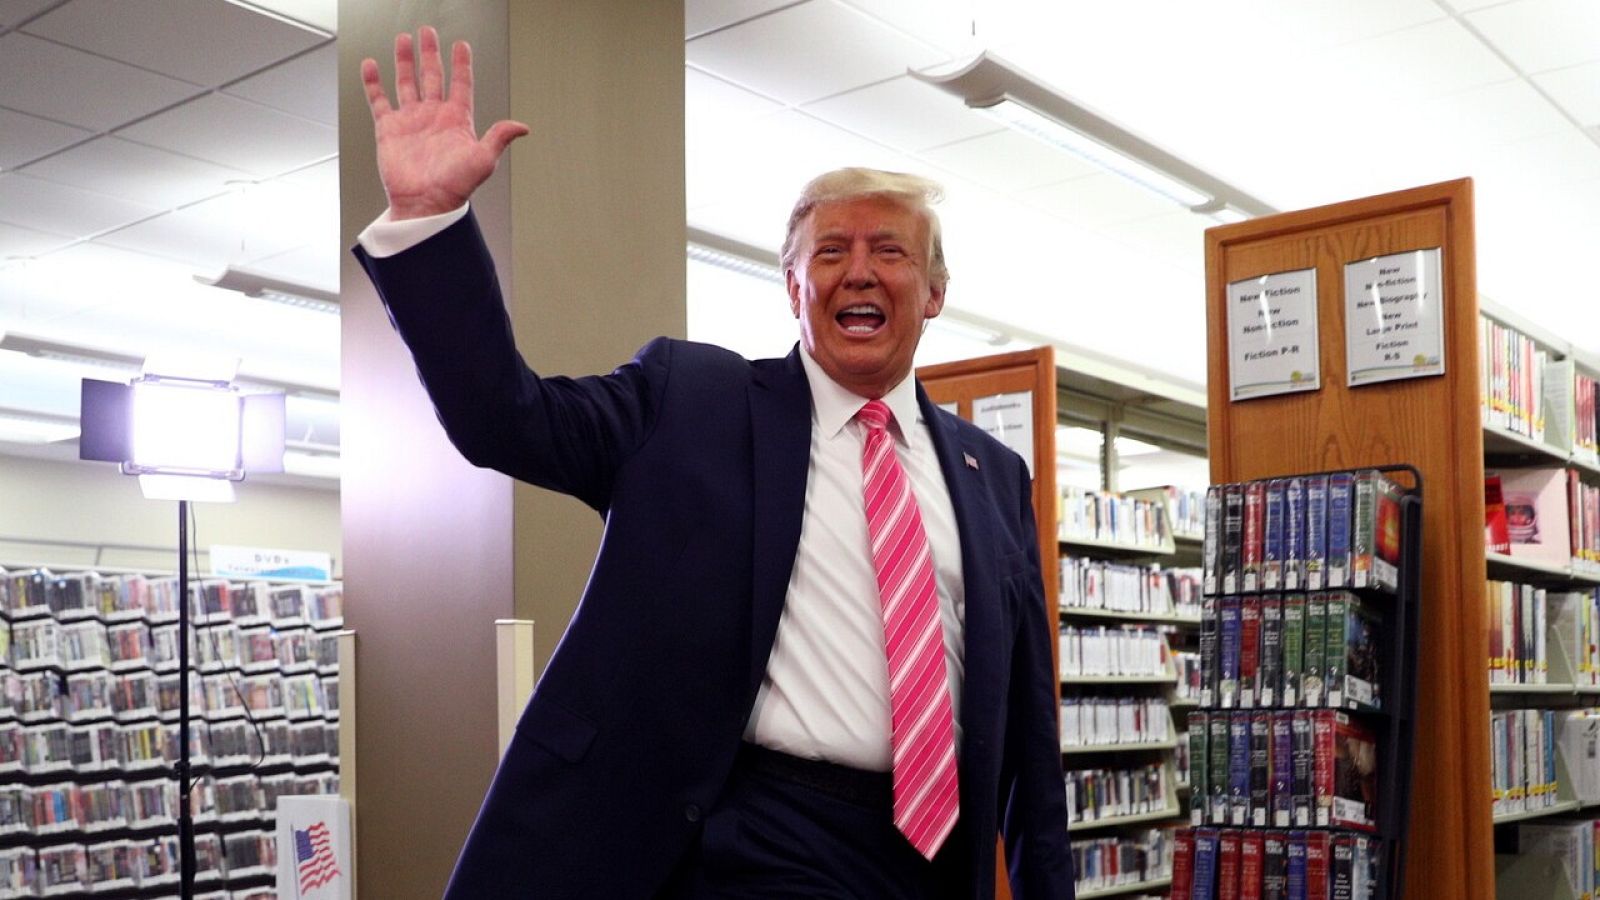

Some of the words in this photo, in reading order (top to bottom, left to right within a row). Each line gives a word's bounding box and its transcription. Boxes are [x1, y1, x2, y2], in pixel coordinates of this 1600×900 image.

[1379, 266, 1401, 276] New
[1264, 286, 1301, 297] Fiction
[1394, 320, 1419, 331] Print
[1375, 339, 1410, 350] Fiction
[1244, 349, 1279, 361] Fiction
